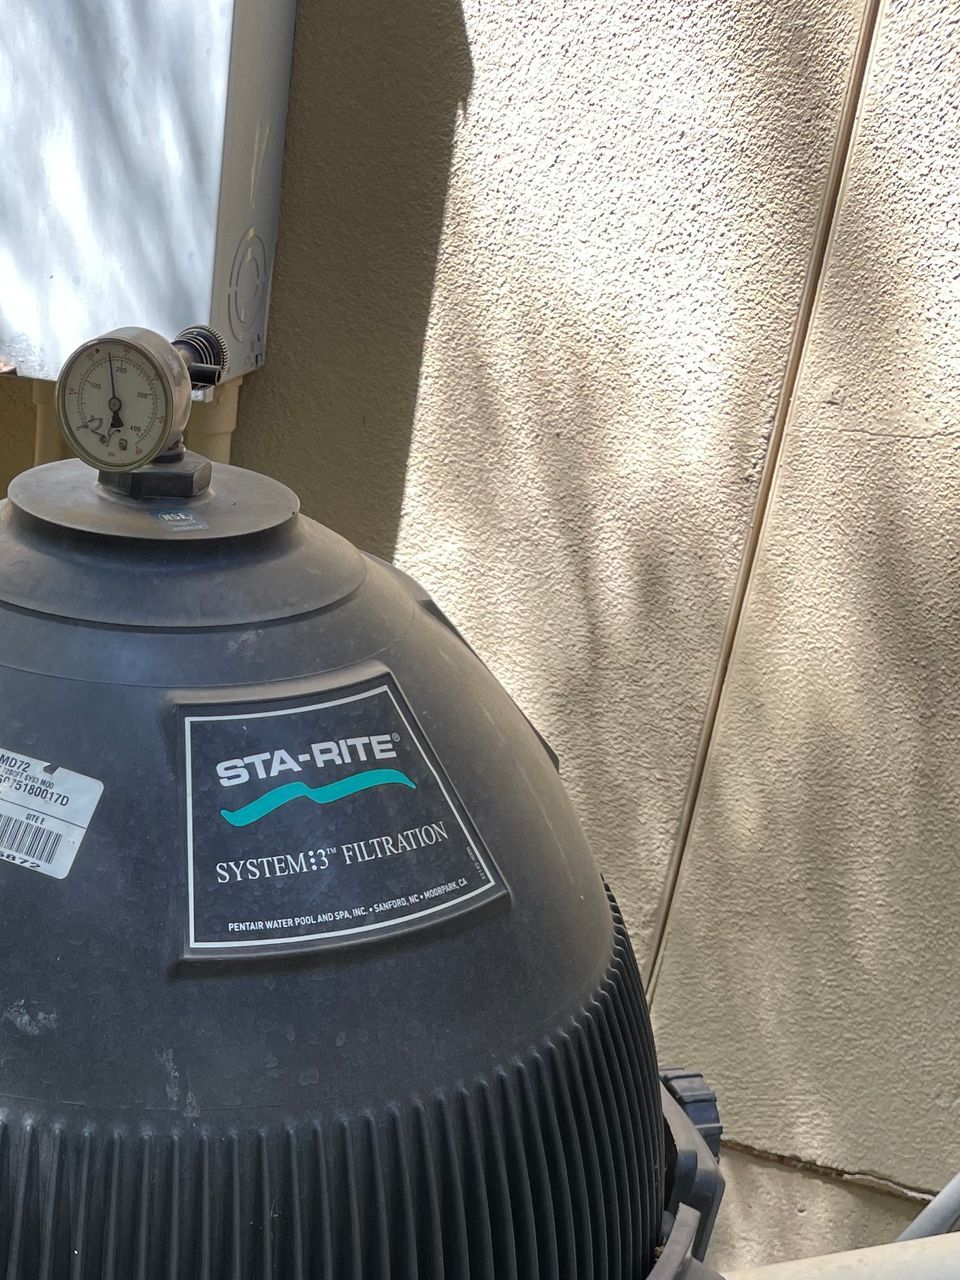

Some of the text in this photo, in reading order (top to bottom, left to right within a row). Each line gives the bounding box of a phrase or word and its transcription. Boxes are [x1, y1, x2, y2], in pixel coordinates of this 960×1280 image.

[24, 812, 39, 823] SITE
[341, 821, 449, 865] FILTRATION
[228, 877, 468, 932] PENTAIR WATER POOL AND SPA, INC. SANFORD, NC MOORPARK, CA
